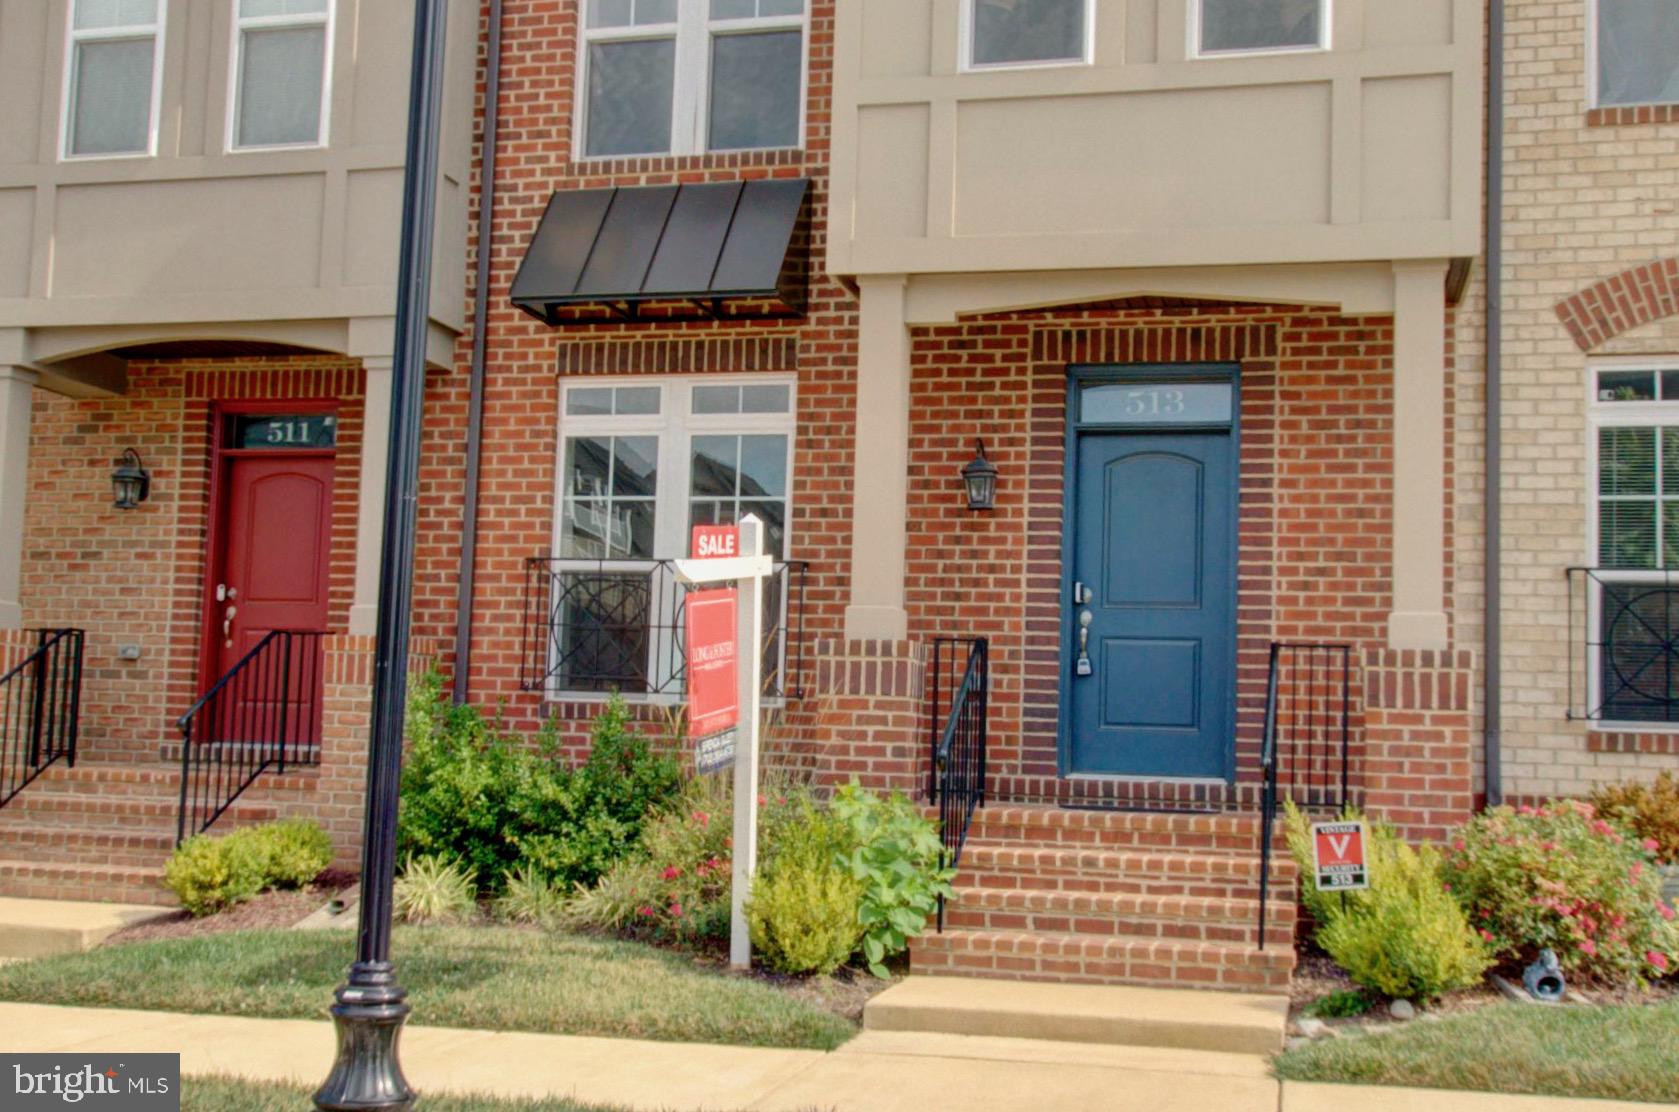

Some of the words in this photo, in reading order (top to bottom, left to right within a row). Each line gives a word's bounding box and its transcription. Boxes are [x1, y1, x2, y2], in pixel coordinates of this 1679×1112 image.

[1125, 390, 1185, 415] 513
[267, 421, 310, 443] 511
[698, 534, 735, 556] SALE
[1327, 834, 1351, 860] V
[1331, 873, 1353, 886] 513
